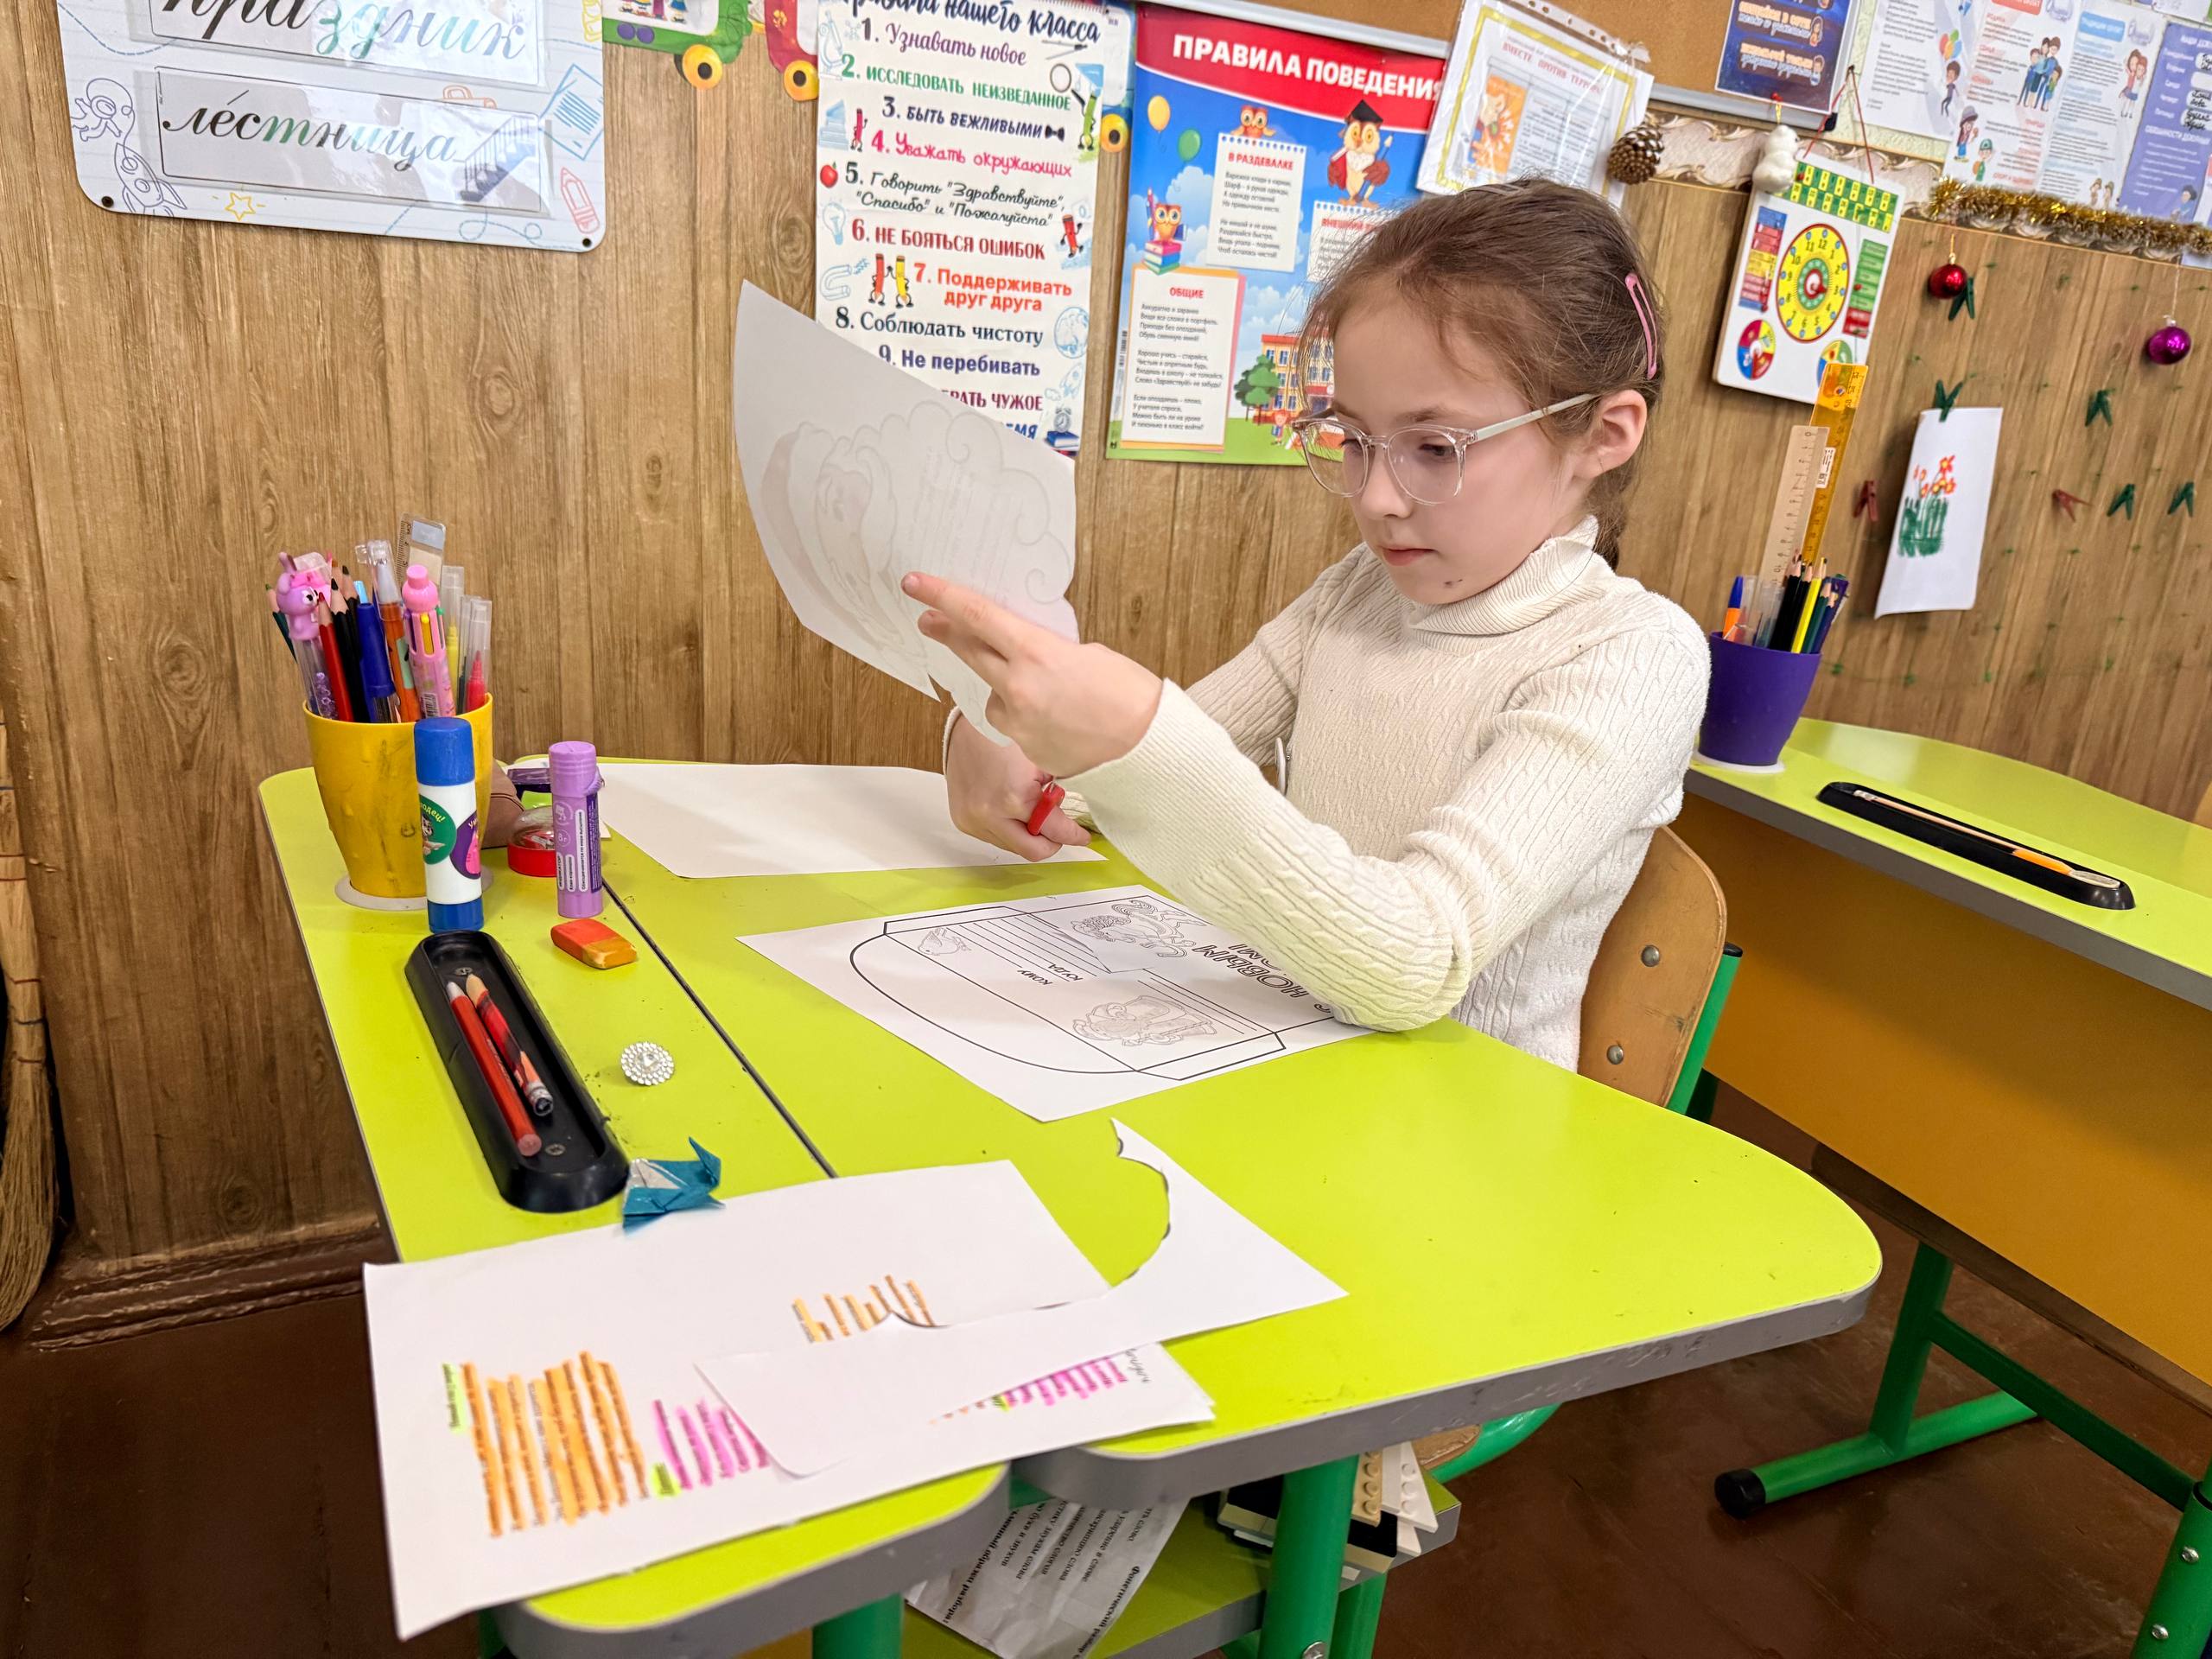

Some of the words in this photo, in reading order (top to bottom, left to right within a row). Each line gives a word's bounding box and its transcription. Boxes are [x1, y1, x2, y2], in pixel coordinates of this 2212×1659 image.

[861, 17, 879, 41] 1.
[885, 22, 976, 56] Узнавать
[981, 41, 1027, 66] новое
[1028, 10, 1100, 42] класса
[1173, 34, 1302, 79] ПРАВИЛА
[841, 54, 861, 79] 2.
[867, 66, 964, 94] ИССЛЕДОВАТЬ
[972, 82, 1071, 111] НЕИЗВЕДАННОЕ
[882, 97, 900, 119] 3.
[906, 106, 945, 124] БЫТЬ
[950, 113, 1043, 138] ВЕЖЛИВЫМИ
[871, 130, 891, 153] 4.
[896, 132, 966, 163] Уважать
[974, 151, 1072, 177] окружающих
[1228, 152, 1235, 162] В
[1236, 154, 1294, 170] РАЗДЕВАЛКЕ
[845, 162, 864, 185] 5.
[870, 172, 943, 195] Говорить
[856, 190, 931, 213] "Спасибо"
[934, 206, 945, 216] и
[949, 202, 1053, 227] "Пожалуйста"
[851, 218, 870, 242] 6.
[875, 226, 896, 245] НЕ
[901, 229, 975, 253] БОЯТЬСЯ
[979, 238, 1046, 260] ОШИБОК
[913, 263, 931, 284] 7.
[937, 268, 1073, 296] Поддерживать
[1169, 287, 1204, 300] ОБЩИЕ
[944, 289, 988, 309] друг
[991, 295, 1043, 314] друга
[836, 307, 855, 329] 8.
[860, 312, 966, 340] Соблюдать
[972, 327, 1045, 348] чистоту
[901, 349, 927, 369] Не
[931, 353, 1041, 377] перебивать
[991, 393, 1044, 411] ЧУЖОЕ
[1017, 969, 1052, 986] КОМУ
[1048, 963, 1084, 981] КУДА
[1192, 944, 1309, 999] НОВЫМ
[1098, 1565, 1141, 1628] Фонетический
